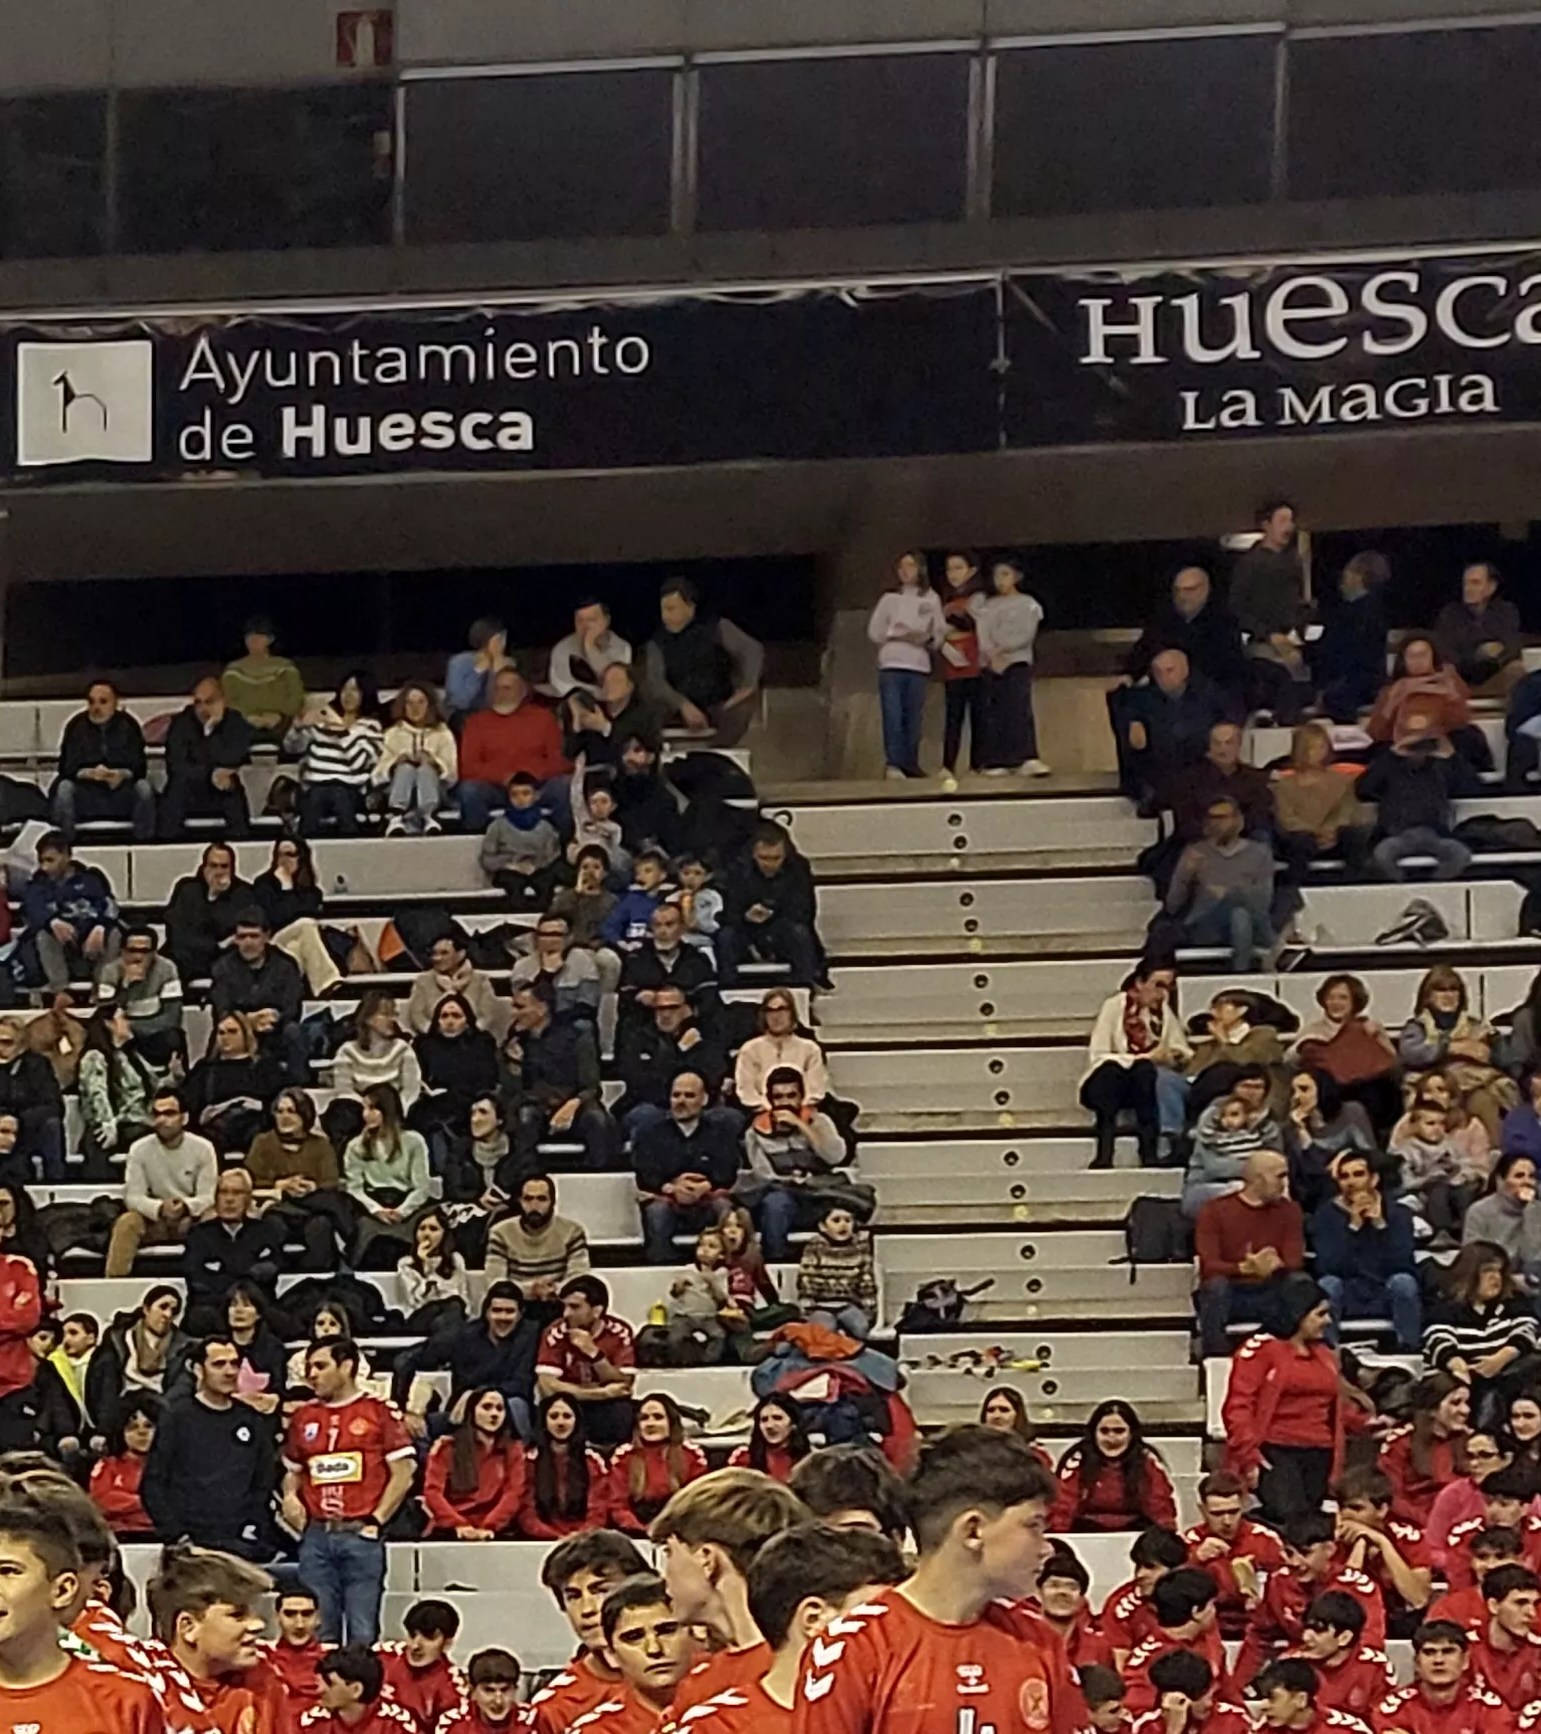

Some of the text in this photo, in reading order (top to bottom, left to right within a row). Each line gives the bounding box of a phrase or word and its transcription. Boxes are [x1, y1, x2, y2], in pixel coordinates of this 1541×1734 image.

[179, 325, 650, 404] Ayuntamiento
[180, 405, 533, 460] de Huesca
